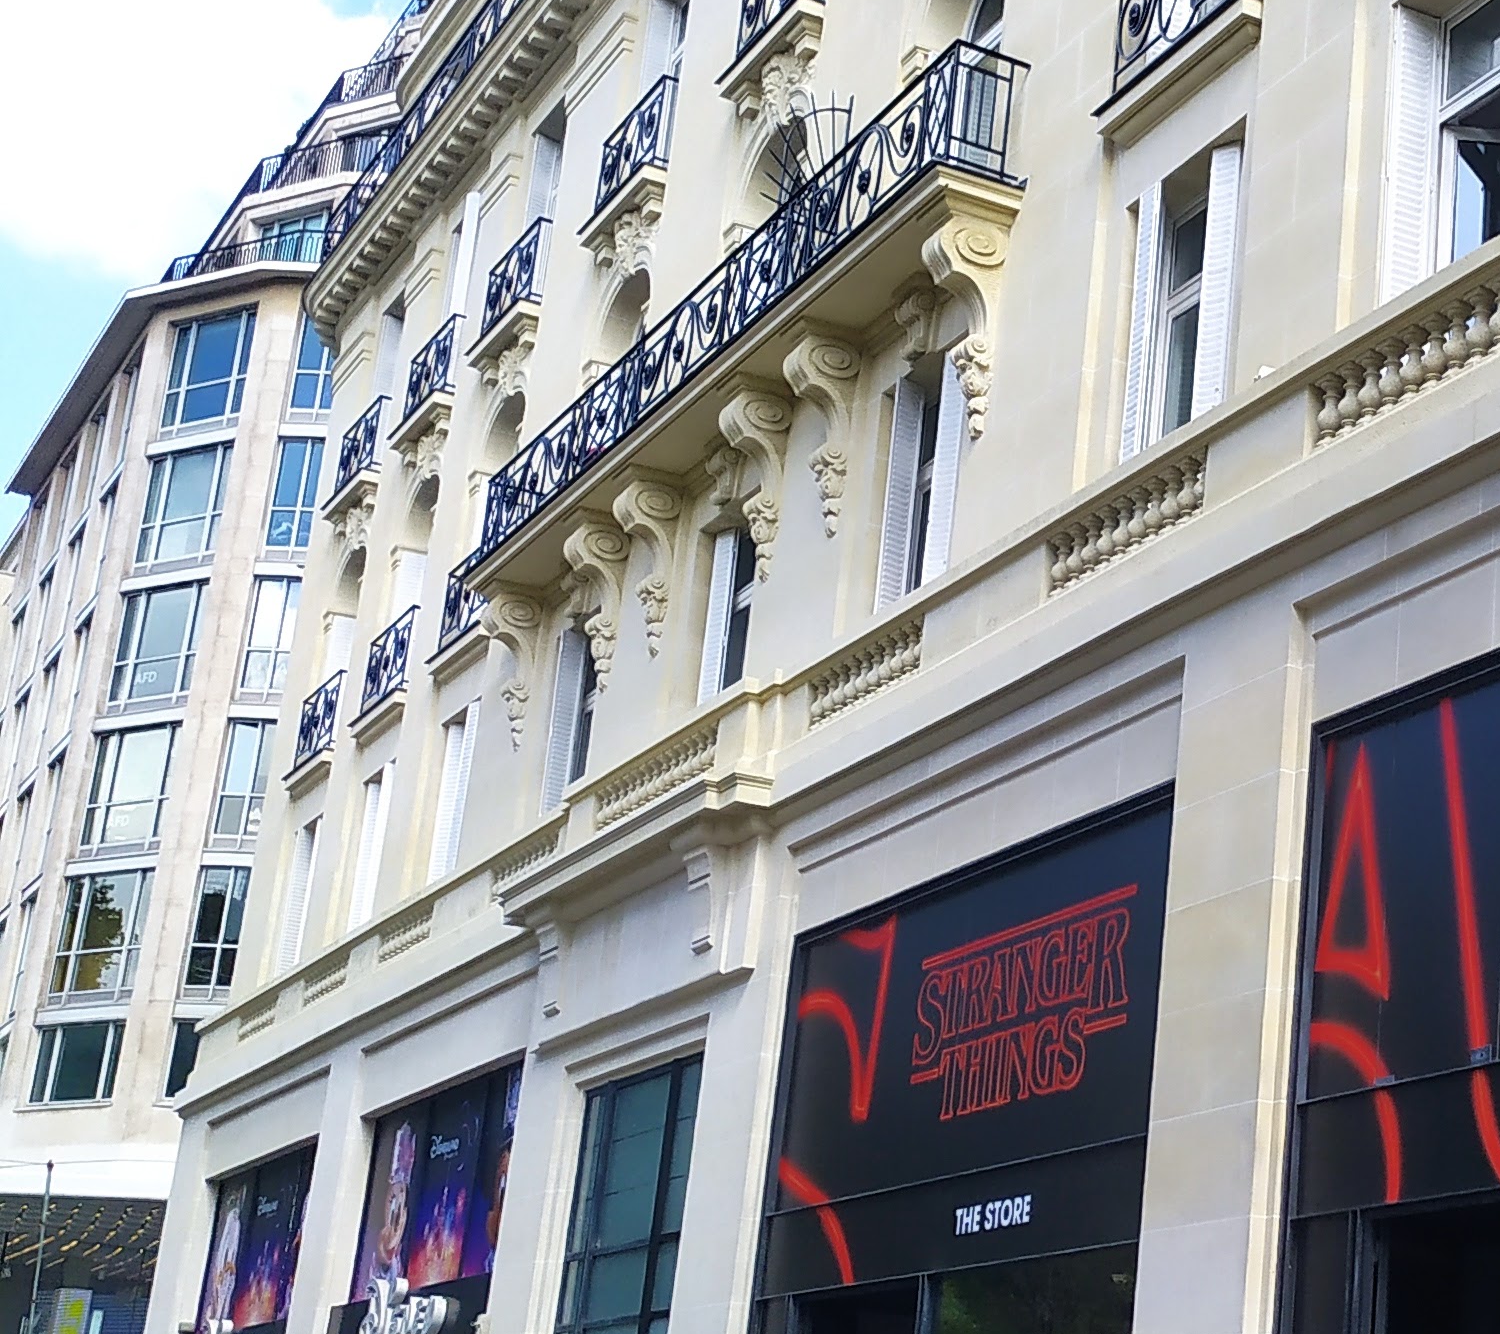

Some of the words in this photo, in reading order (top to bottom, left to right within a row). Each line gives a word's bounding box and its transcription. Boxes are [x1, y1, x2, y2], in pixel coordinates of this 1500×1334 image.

[912, 906, 1131, 1066] STRANGER
[938, 1006, 1087, 1121] THINGS
[955, 1204, 982, 1236] THE
[984, 1194, 1032, 1231] STORE
